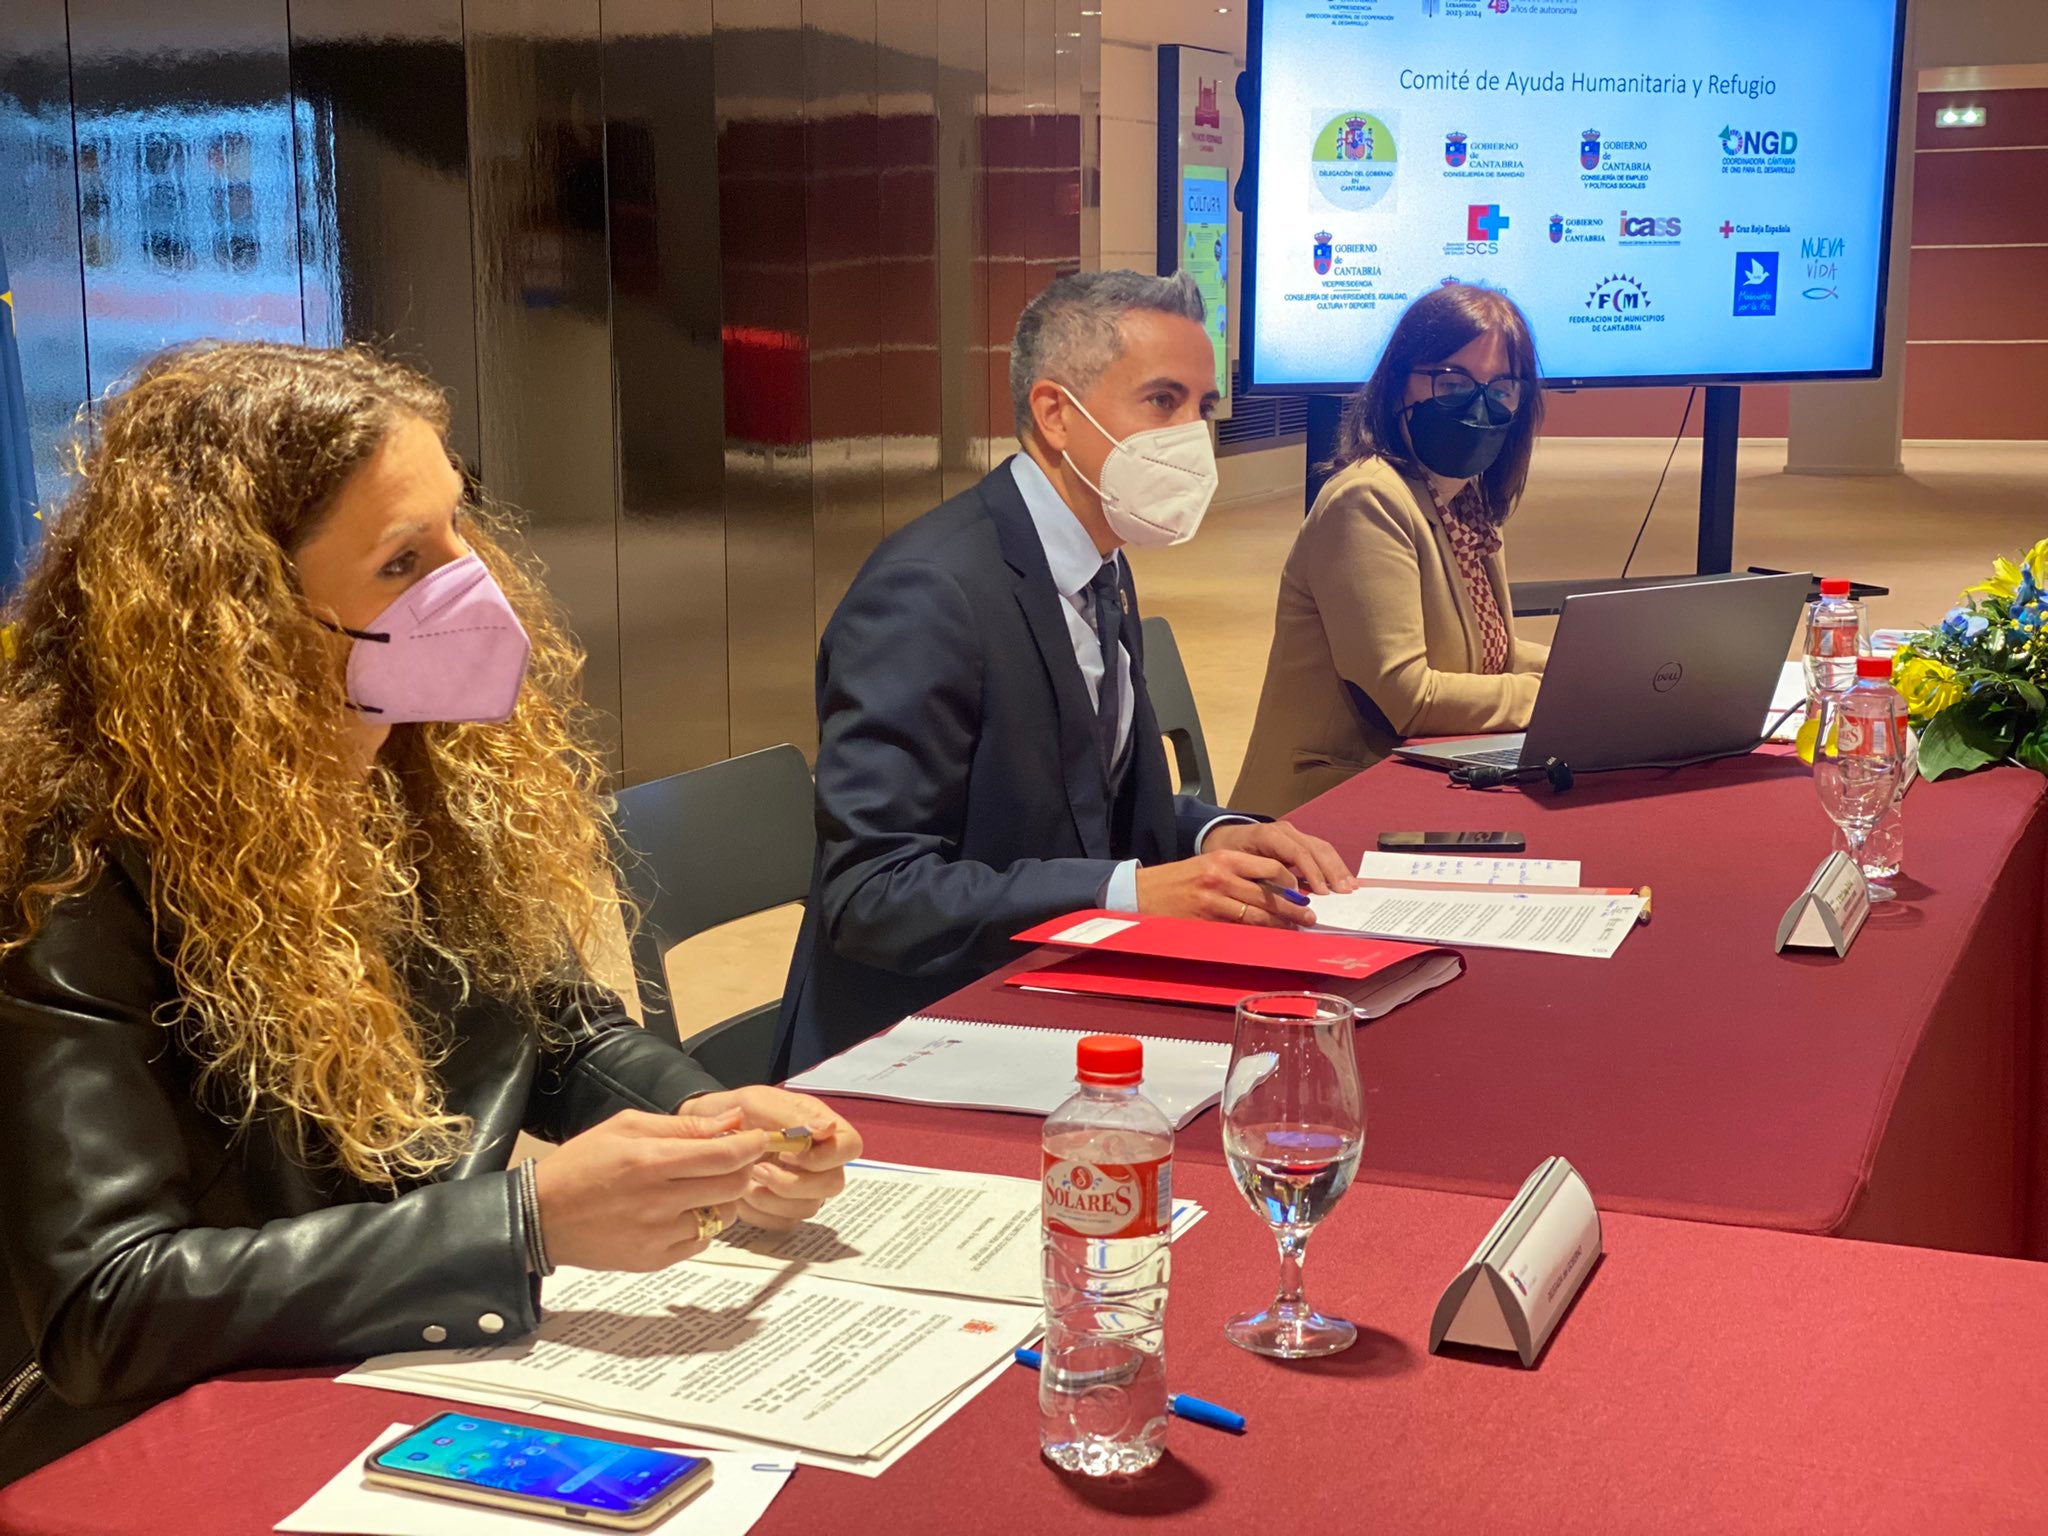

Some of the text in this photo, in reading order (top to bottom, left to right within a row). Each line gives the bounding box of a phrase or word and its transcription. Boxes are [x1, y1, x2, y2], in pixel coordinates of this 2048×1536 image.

[1529, 5, 1538, 13] de
[1400, 69, 1776, 100] Comité de Ayuda Humanitaria y Refugio
[1603, 141, 1648, 150] GOBIERNO
[1719, 127, 1798, 155] ONGD
[1470, 142, 1519, 150] GOBIERNO
[1602, 152, 1611, 160] de
[1469, 160, 1524, 168] CANTABRIA
[1722, 157, 1766, 165] COORDINADORA
[1602, 162, 1652, 171] CANTABRIA
[1722, 166, 1729, 174] DE
[1742, 166, 1756, 174] PARA
[1757, 166, 1763, 174] EL
[1764, 166, 1796, 174] DESARROLLO
[1565, 219, 1603, 227] GOBIERNO
[1619, 210, 1682, 237] icass
[1565, 235, 1606, 243] CANTABRIA
[1334, 244, 1378, 253] GOBIERNO
[1465, 242, 1499, 255] SCS
[1801, 236, 1846, 259] NUEVA
[1334, 256, 1343, 264] de
[1334, 266, 1382, 276] CANTABRIA
[1321, 293, 1329, 301] DE
[1317, 302, 1344, 310] CULTURA
[1349, 301, 1377, 309] DEPORTE
[1613, 315, 1622, 323] DE
[1623, 314, 1665, 323] MUNICIPIOS
[1602, 324, 1642, 332] CANTABRIA
[1045, 1175, 1133, 1217] SOLARES
